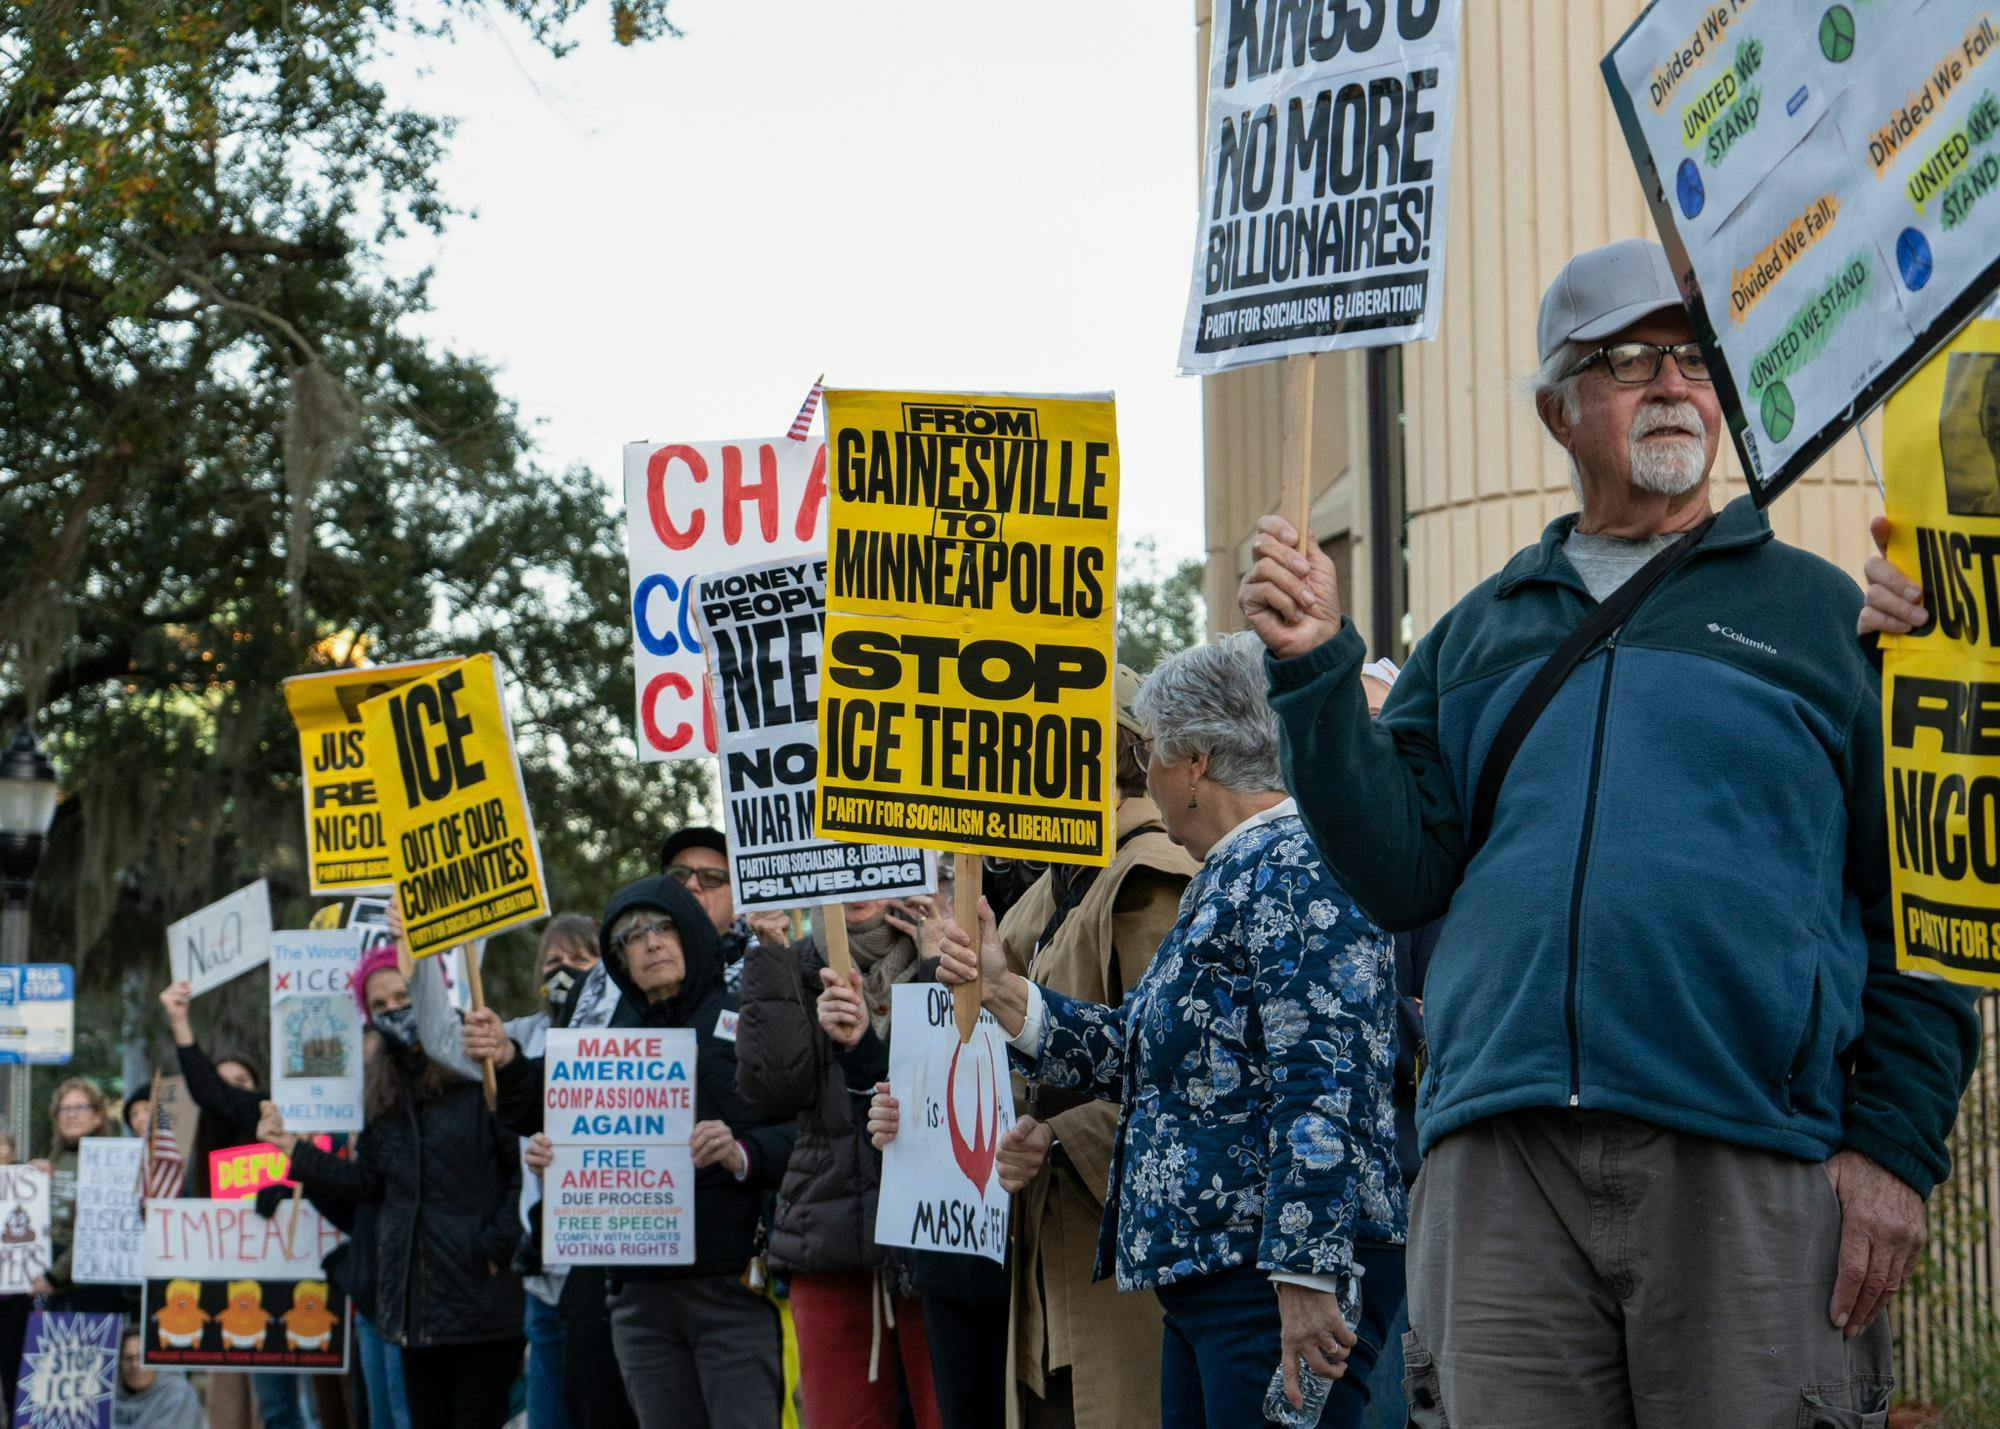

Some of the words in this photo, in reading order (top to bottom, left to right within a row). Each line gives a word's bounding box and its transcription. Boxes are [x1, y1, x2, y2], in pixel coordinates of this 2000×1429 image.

[1650, 32, 1705, 107] Divided
[1703, 9, 1729, 41] We
[1682, 73, 1736, 139] UNITED
[1735, 41, 1761, 83] WE
[1869, 86, 1934, 167] Divided
[1933, 62, 1962, 97] We
[1963, 17, 2000, 66] Fall,
[1212, 103, 1278, 221] NO
[1282, 67, 1438, 205] MORE
[1708, 96, 1759, 160] STAND
[1909, 133, 1970, 203] UNITED
[1969, 98, 2000, 141] WE
[1942, 156, 2000, 226] STAND
[1205, 185, 1434, 296] BILLIONAIRES!
[1732, 257, 1783, 312] Divided
[1780, 230, 1806, 260] We
[1804, 197, 1836, 237] Fall,
[1204, 311, 1238, 340] PARTY
[1238, 306, 1261, 334] FOR
[1262, 294, 1330, 328] SOCIALISM
[1334, 294, 1345, 320] &
[1345, 283, 1423, 318] LIBERATION
[1751, 332, 1800, 389] UNITED
[1800, 306, 1823, 340] WE
[1821, 261, 1866, 318] STAND
[909, 408, 1032, 437] FROM
[837, 427, 1109, 520] GAINESVILLE
[940, 512, 996, 539] TO
[700, 564, 807, 601] MONEY
[834, 528, 1104, 619] MINNEAPOLIS
[1721, 626, 1777, 655] Columbia
[713, 612, 827, 732] NEE
[829, 630, 1107, 703] STOP
[314, 729, 365, 772] JUS
[389, 669, 486, 809] ICE
[826, 697, 905, 784] ICE
[915, 704, 1102, 802] TERROR
[727, 742, 818, 792] NO
[401, 823, 438, 873] OUT
[438, 812, 464, 858] OF
[464, 798, 508, 850] OUR
[732, 793, 792, 848] WAR
[827, 795, 874, 825] PARTY
[876, 801, 905, 828] FOR
[906, 803, 983, 836] SOCIALISM
[987, 813, 1006, 838] &
[1009, 813, 1097, 847] LIBERATION
[1893, 767, 2000, 885] NICO
[400, 838, 529, 920] COMMUNITIES
[739, 856, 770, 879] PARTY
[771, 855, 790, 875] FOR
[790, 847, 845, 874] SOCIALISM
[847, 846, 862, 867] &
[861, 845, 921, 864] LIBERATION
[742, 862, 922, 899] PSLWEB.ORG
[274, 945, 301, 960] The
[308, 945, 358, 962] Wrong
[1908, 906, 1947, 954] PARTY
[1950, 917, 1989, 959] FOR
[23, 981, 65, 997] STOP
[26, 967, 60, 980] BUS
[296, 968, 341, 992] ICE
[577, 1038, 662, 1057] MAKE
[551, 1061, 686, 1080] AMERICA
[279, 1103, 354, 1119] MELTING
[547, 1087, 690, 1109] COMPASSIONATE
[571, 1115, 664, 1135] AGAIN
[217, 1152, 287, 1190] DEFU
[561, 1170, 675, 1188] AMERICA
[583, 1150, 646, 1168] FREE
[554, 1207, 615, 1215] BIRTHRIGHT
[619, 1207, 683, 1215] CITIZENSHIP
[562, 1192, 593, 1205] DUE
[598, 1192, 674, 1205] PROCESS
[555, 1232, 600, 1241] COMPLY
[603, 1232, 631, 1241] WITH
[635, 1232, 680, 1241] COURTS
[558, 1217, 602, 1230] FREE
[608, 1216, 678, 1230] SPEECH
[911, 1200, 978, 1252] MASK
[556, 1243, 615, 1255] VOTING
[620, 1243, 678, 1255] RIGHTS
[52, 1346, 97, 1374] STOP
[47, 1376, 85, 1401] ICE
